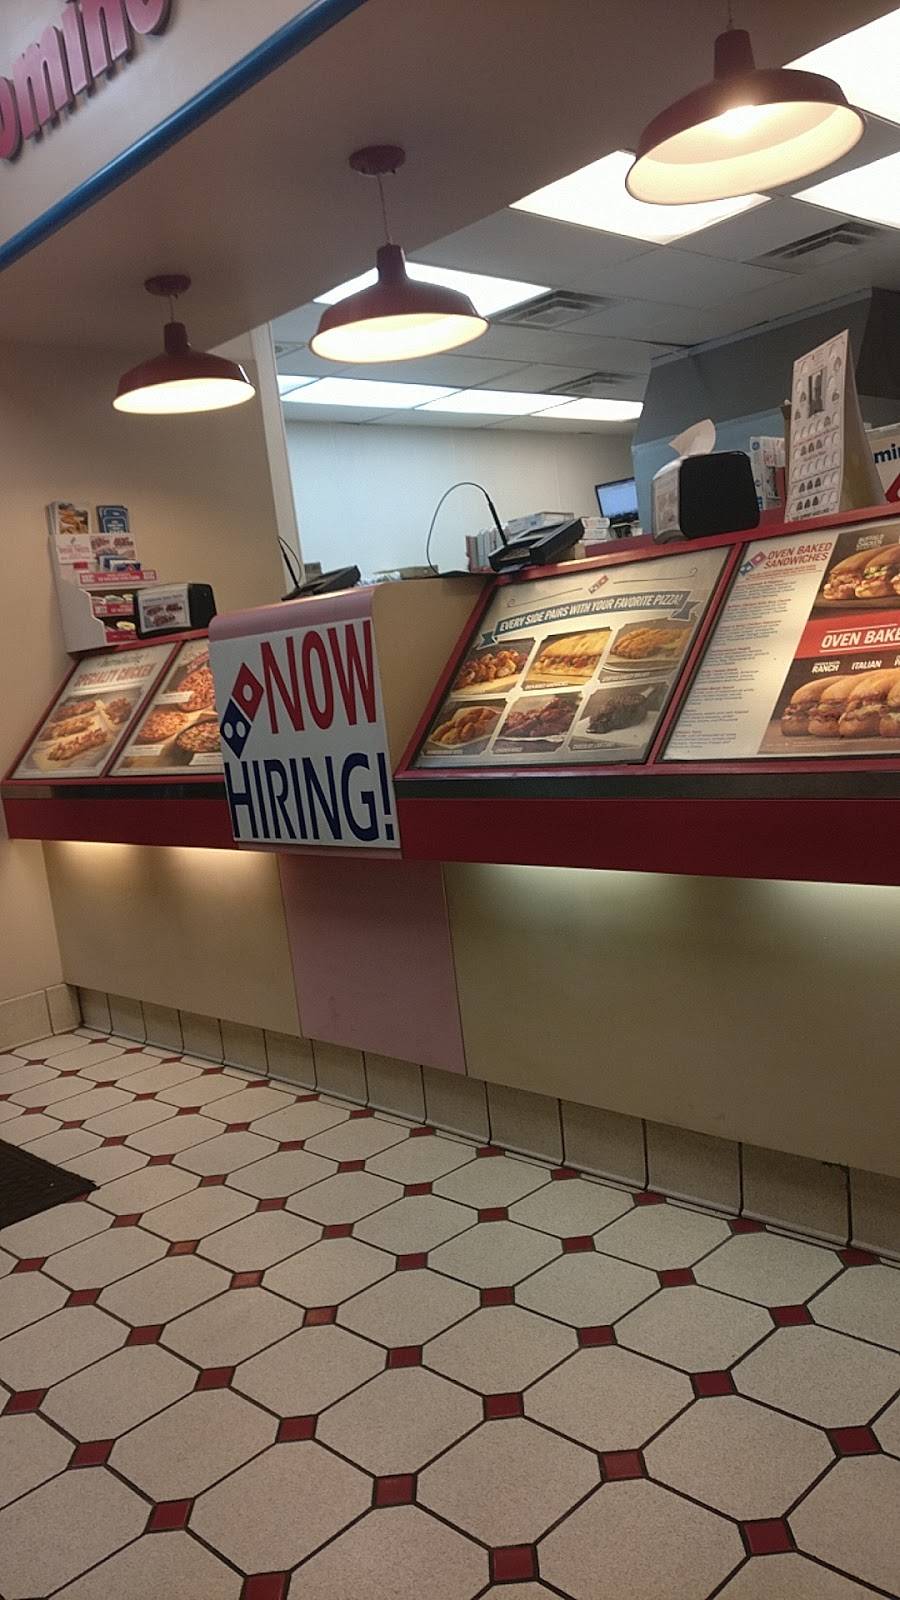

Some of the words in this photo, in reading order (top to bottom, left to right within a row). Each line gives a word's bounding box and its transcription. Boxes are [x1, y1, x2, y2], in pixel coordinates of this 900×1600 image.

[768, 547, 795, 560] OVEN
[797, 542, 833, 555] BAKED
[763, 552, 829, 570] SANDWICHES
[499, 617, 525, 632] EVERY
[524, 612, 545, 625] SIDE
[544, 605, 570, 621] PAIRS
[569, 602, 591, 616] WITH
[589, 599, 615, 612] YOUR
[613, 595, 653, 610] FAVORITE
[654, 594, 684, 606] PIZZA!
[821, 631, 862, 649] OVEN
[811, 664, 840, 674] RANCH
[851, 660, 882, 671] ITALIAN
[260, 619, 377, 734] NOW
[224, 752, 395, 842] HIRING!
